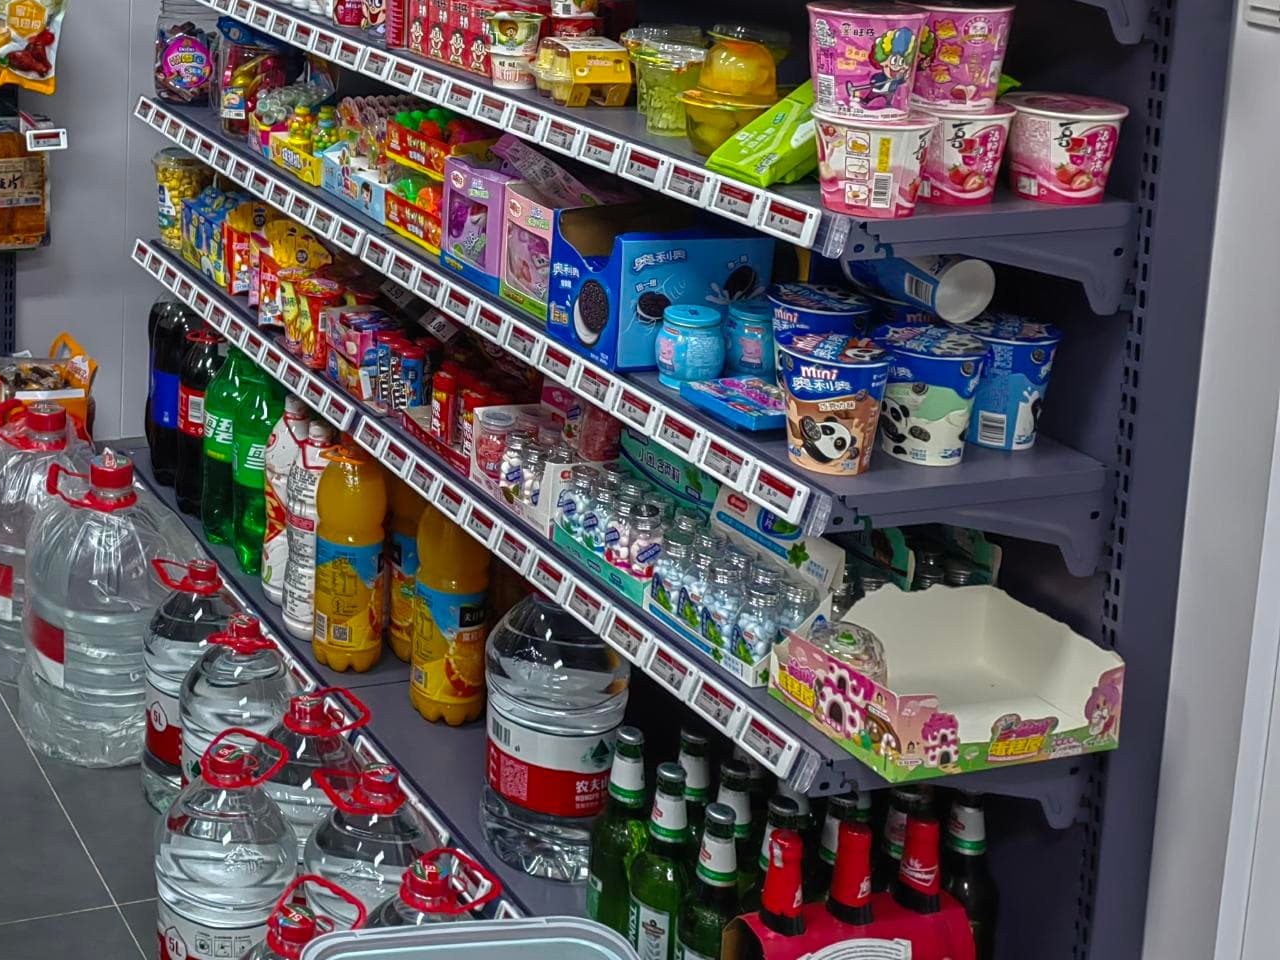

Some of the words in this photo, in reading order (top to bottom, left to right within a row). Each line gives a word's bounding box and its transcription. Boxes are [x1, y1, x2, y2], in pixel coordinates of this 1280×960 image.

[853, 25, 875, 38] 旺仔
[634, 248, 687, 271] 奥利奥
[800, 364, 839, 380] mini
[792, 376, 852, 392] 奥利奥
[151, 708, 165, 725] 5L
[168, 938, 184, 959] 5L
